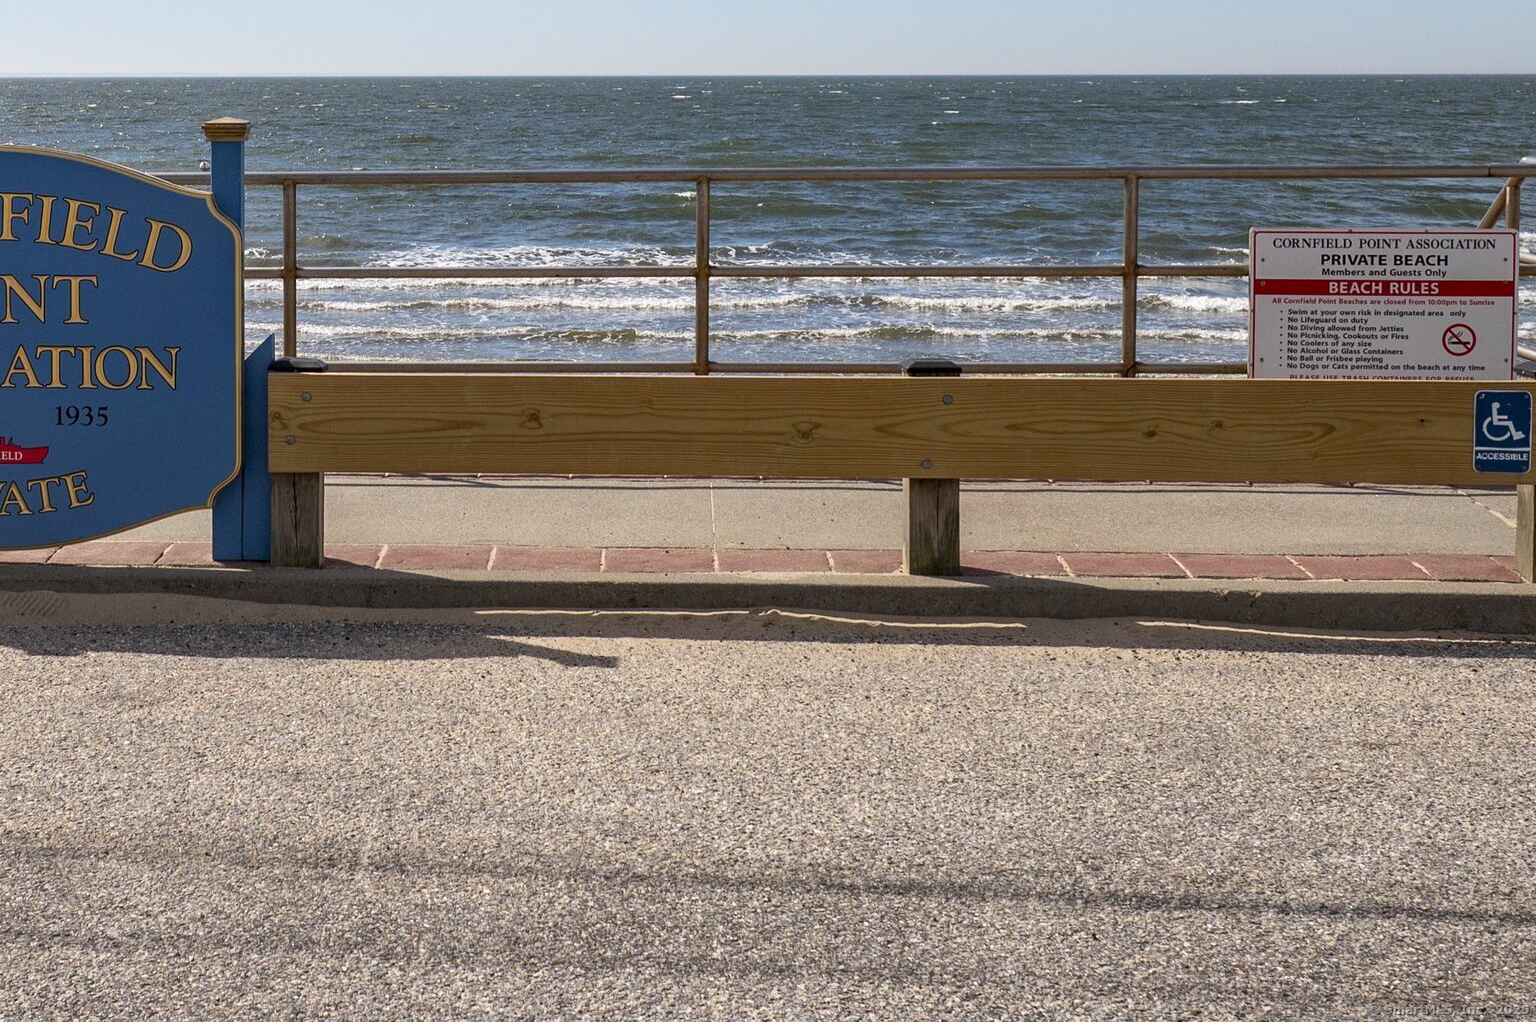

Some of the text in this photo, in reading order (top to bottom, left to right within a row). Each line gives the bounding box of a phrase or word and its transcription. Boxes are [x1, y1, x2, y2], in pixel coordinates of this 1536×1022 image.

[1273, 238, 1496, 250] CORNFIELD POINT ASSOCIATION
[1321, 254, 1449, 266] PRIVATE BEACH
[1321, 268, 1366, 276] Members
[1389, 268, 1422, 277] Guests
[1425, 269, 1447, 278] Only
[1329, 282, 1440, 294] BEACH RULES
[1450, 310, 1466, 318] only
[1351, 317, 1368, 325] duty
[1355, 355, 1384, 364] playing
[1350, 363, 1389, 372] permitted
[55, 405, 109, 428] 1935
[1476, 453, 1529, 461] ACCESSIBLE
